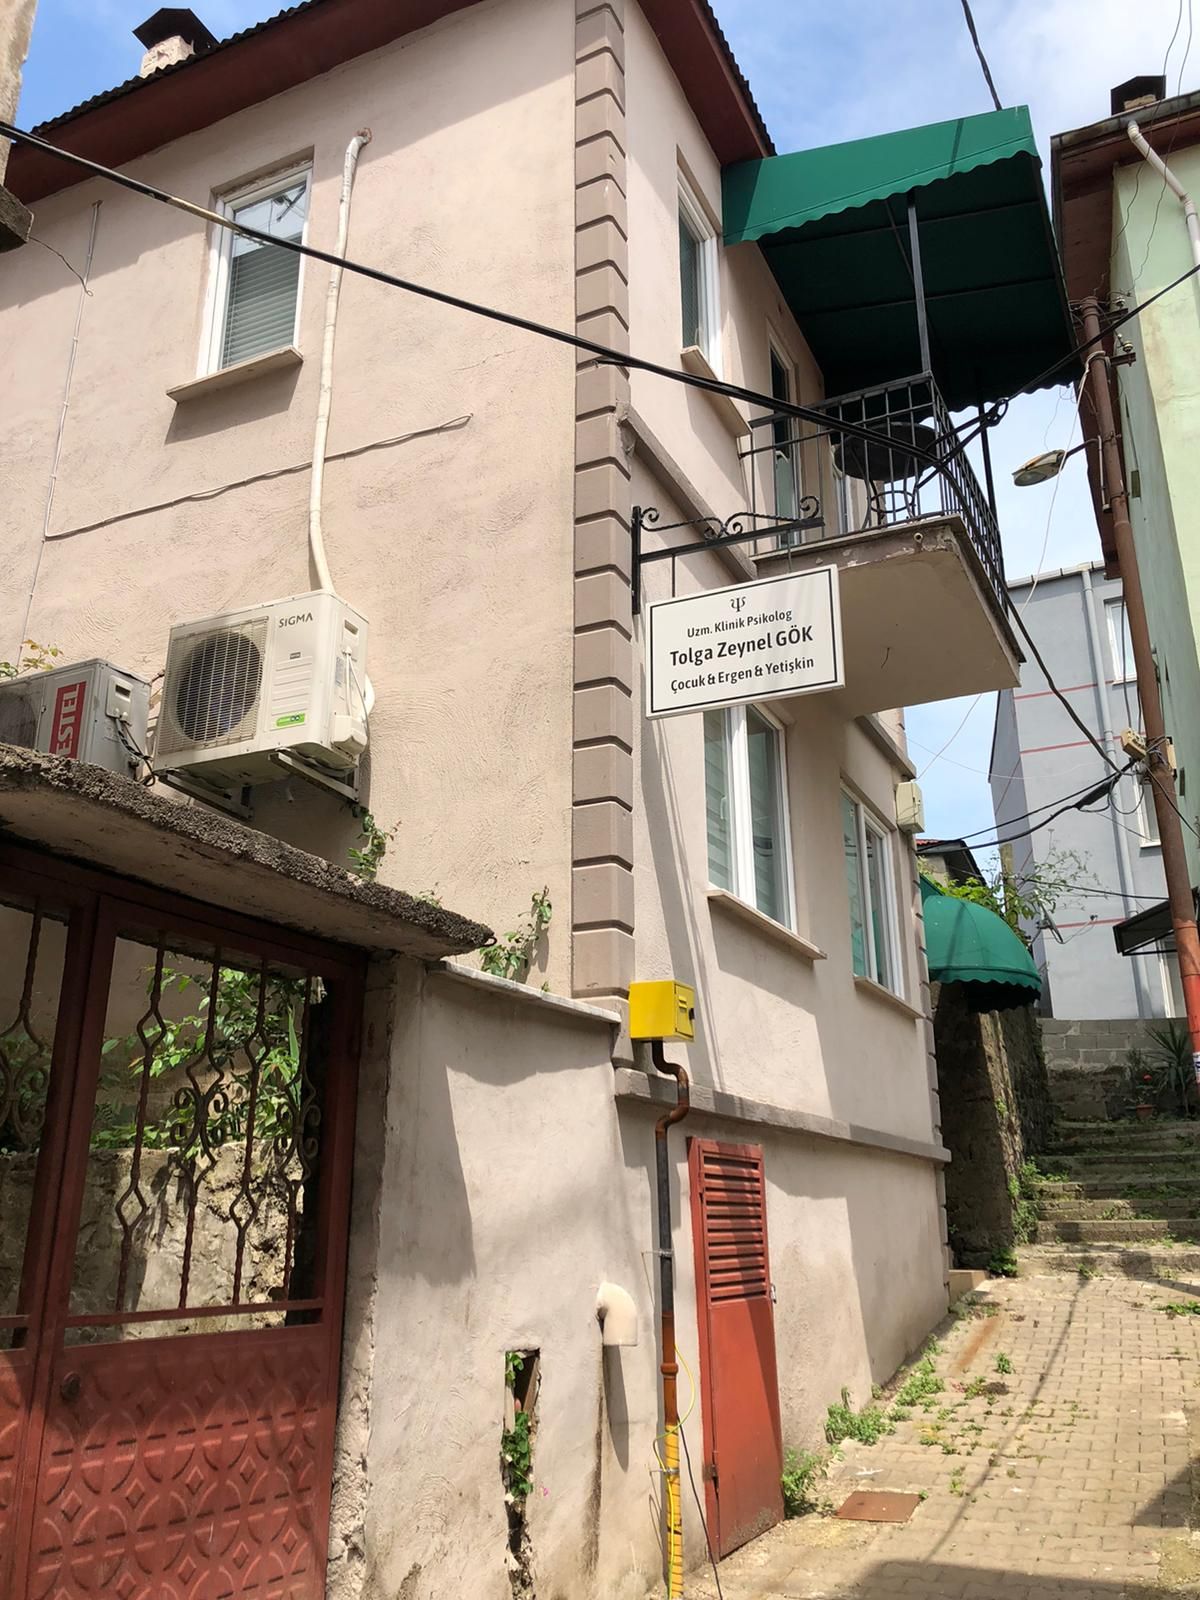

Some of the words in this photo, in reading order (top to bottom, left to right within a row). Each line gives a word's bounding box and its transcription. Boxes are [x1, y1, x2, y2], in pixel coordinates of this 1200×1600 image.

[279, 612, 313, 628] SIGMA
[687, 625, 713, 638] Uzm.
[714, 617, 745, 632] Klinik
[747, 608, 793, 626] Psikolog
[670, 646, 713, 666] Tolga
[717, 632, 773, 659] Zeynel
[775, 625, 814, 647] GÖK
[671, 674, 706, 694] Çocuk
[707, 673, 716, 685] &
[718, 667, 752, 685] Ergen
[754, 665, 764, 676] &
[765, 656, 814, 675] Yetişkin
[55, 683, 81, 756] ESTEL
